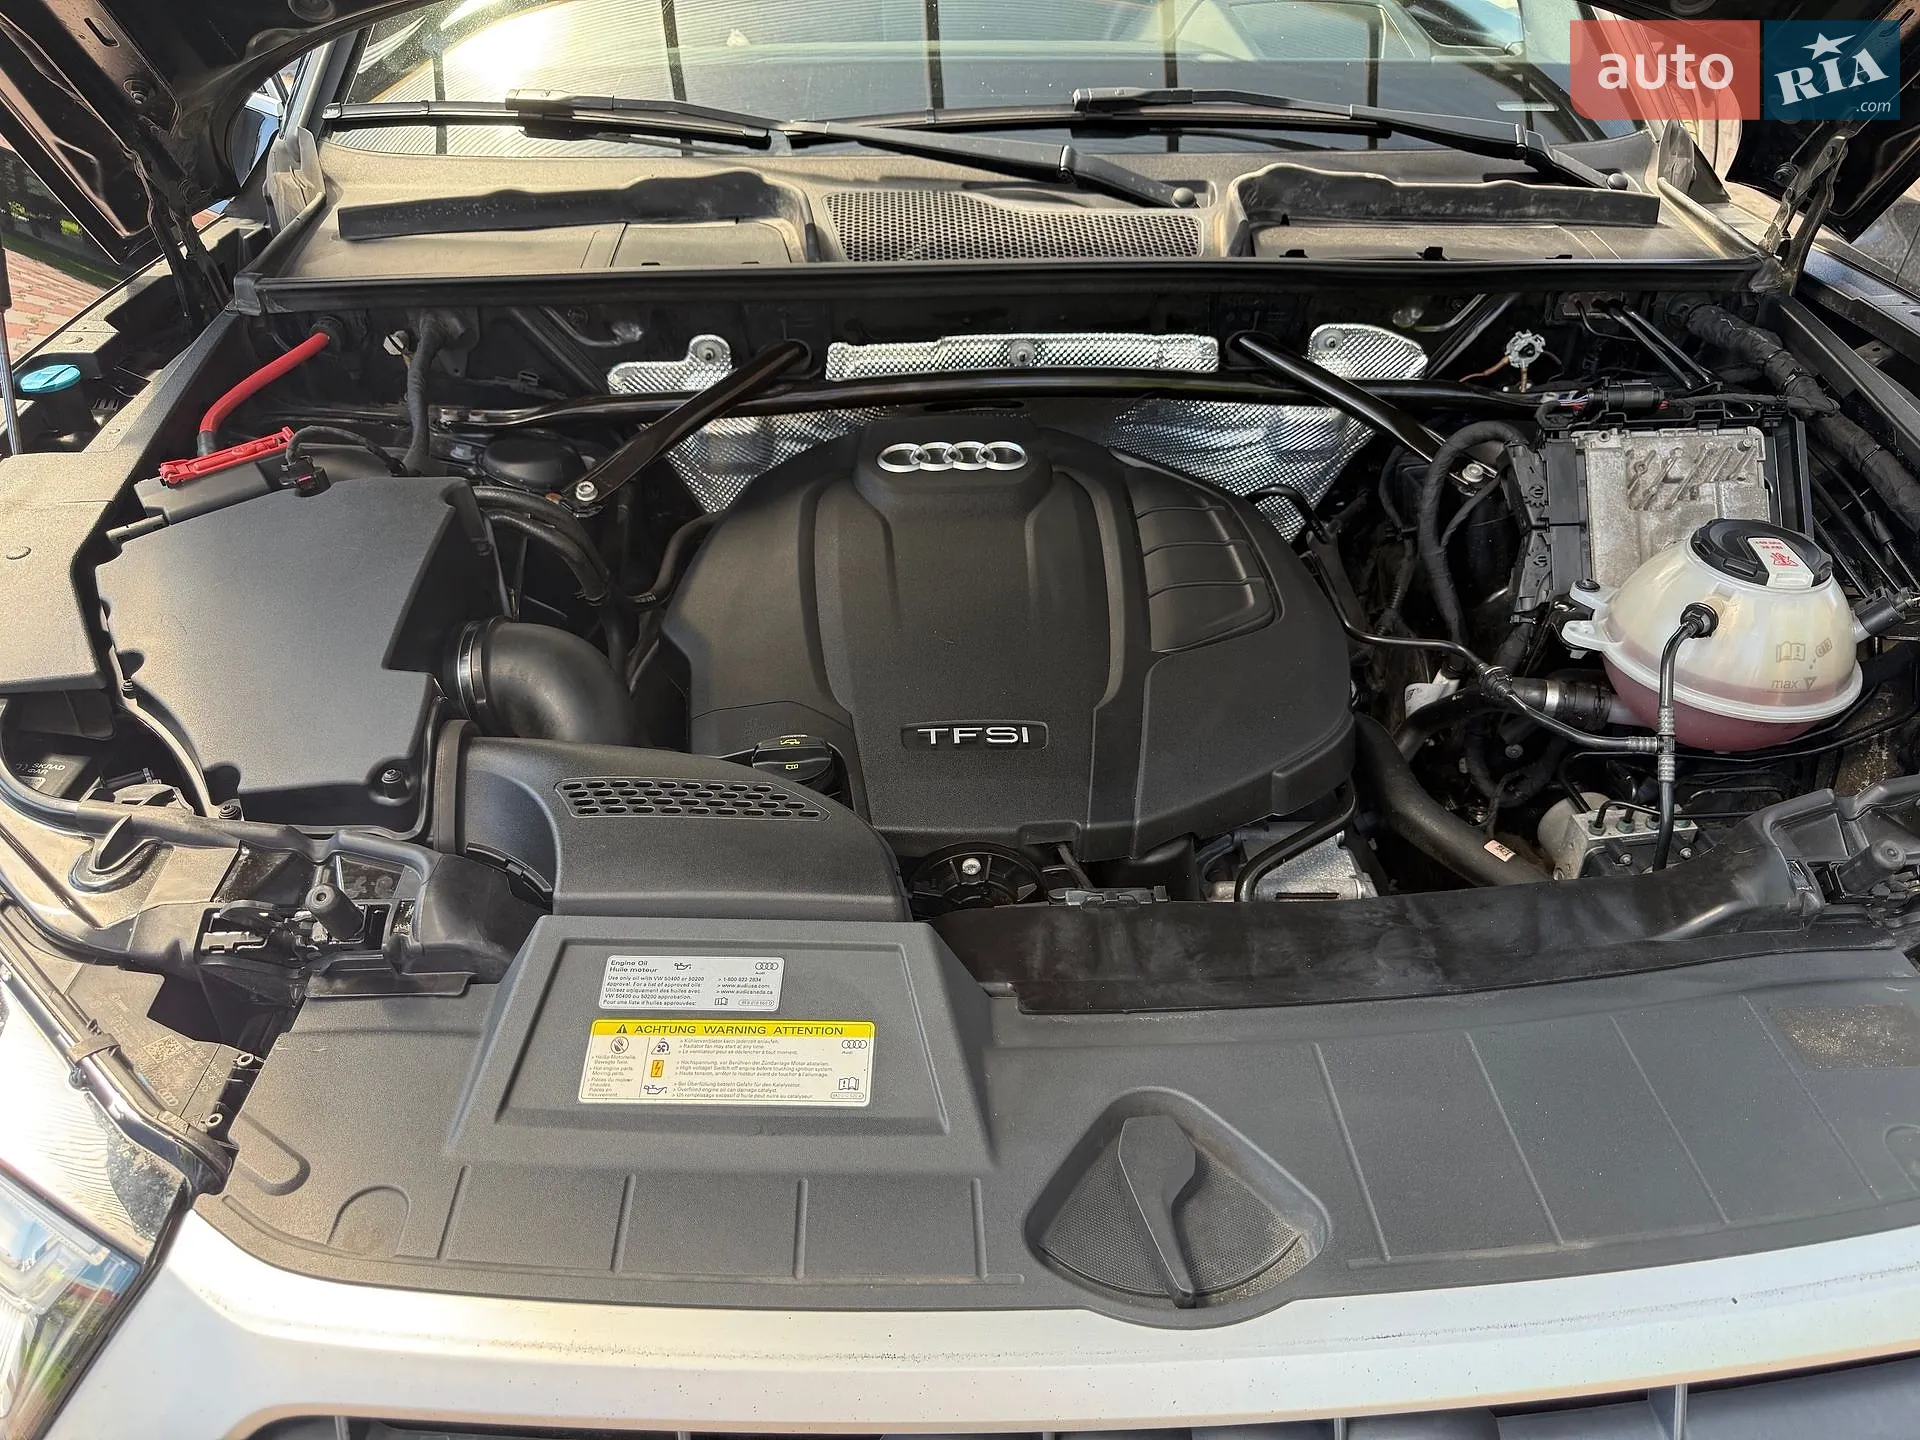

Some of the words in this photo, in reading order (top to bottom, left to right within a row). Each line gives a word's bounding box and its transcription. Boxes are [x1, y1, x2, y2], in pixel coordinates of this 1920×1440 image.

[1771, 680, 1799, 689] max
[917, 726, 1029, 745] TFSI
[634, 1025, 696, 1034] ACHTUNG
[704, 1026, 766, 1034] WARNING
[773, 1026, 844, 1035] ATTENTION
